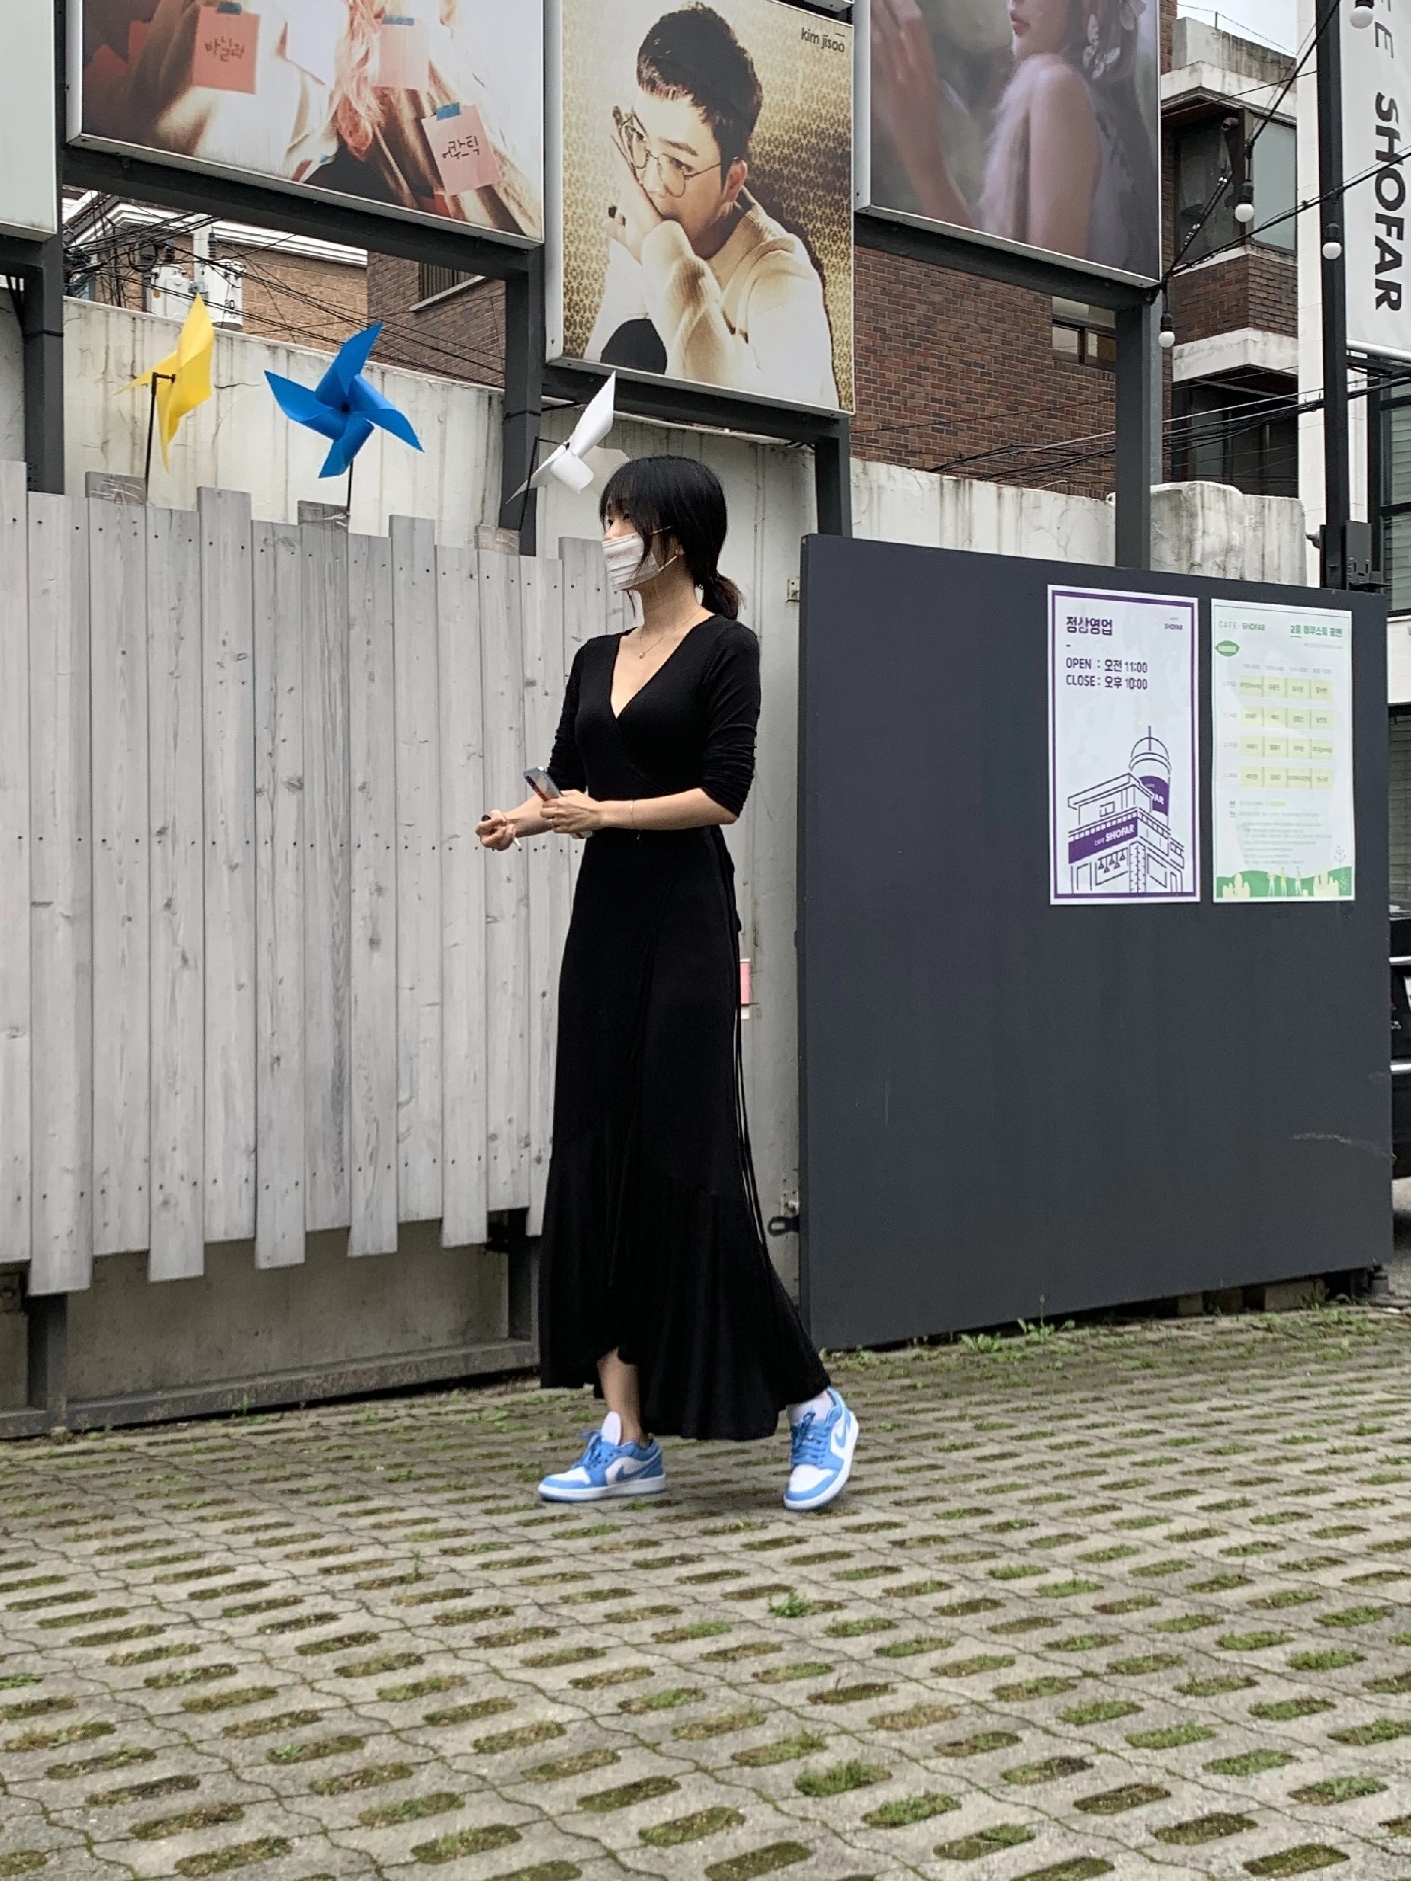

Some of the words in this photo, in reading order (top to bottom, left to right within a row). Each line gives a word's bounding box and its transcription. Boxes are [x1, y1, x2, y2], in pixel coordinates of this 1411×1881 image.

[801, 27, 820, 44] kim
[1375, 91, 1406, 311] SHOFAR
[1066, 616, 1113, 636] 정상영업
[1066, 657, 1093, 670] OPEN
[1104, 659, 1123, 673] 오전
[1124, 661, 1148, 674] 11:00
[1104, 675, 1123, 689] 오후
[1124, 677, 1148, 690] 10:00
[1105, 823, 1136, 844] SHOFAR
